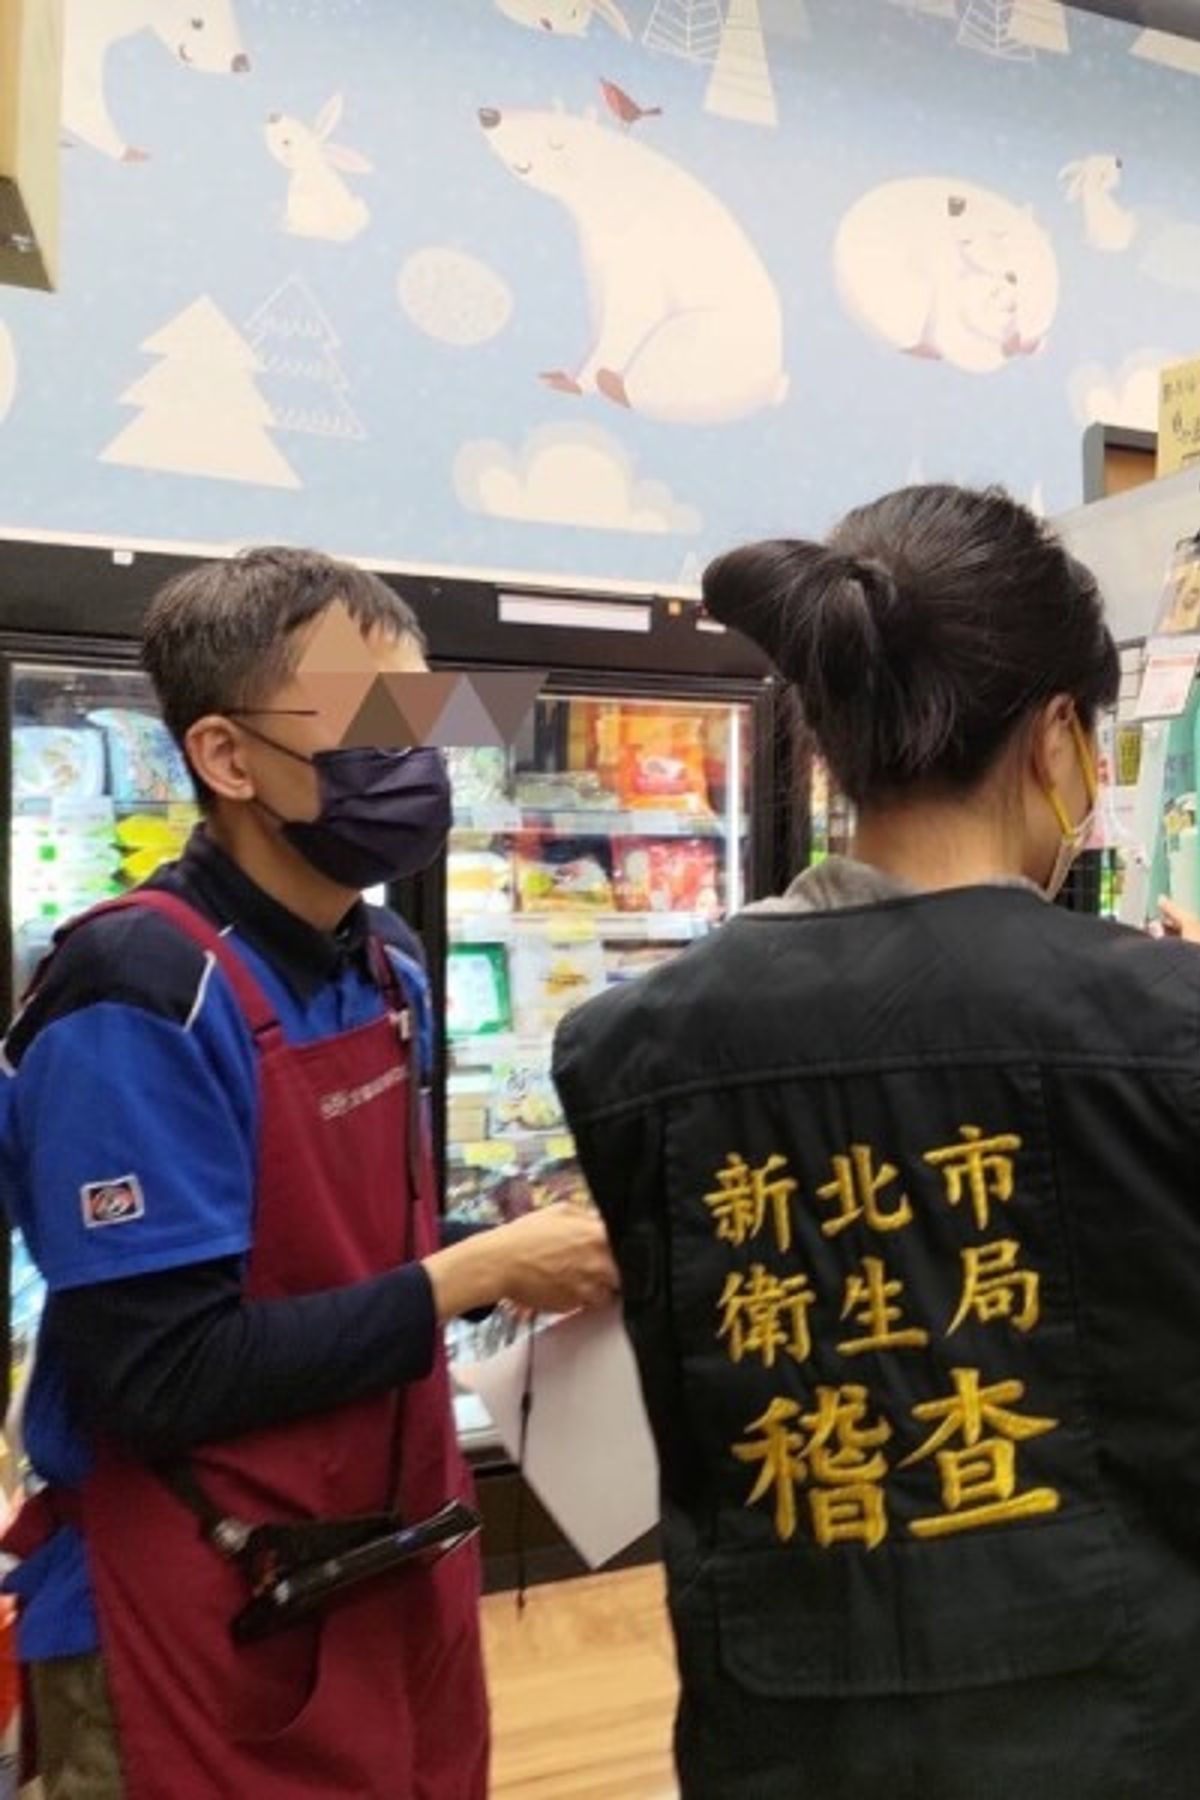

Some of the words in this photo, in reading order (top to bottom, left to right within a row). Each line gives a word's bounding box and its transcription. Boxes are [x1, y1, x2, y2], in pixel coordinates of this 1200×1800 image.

[702, 1124, 1022, 1254] 新北市
[715, 1237, 1041, 1368] 衛生局
[730, 1366, 1061, 1552] 稽查
